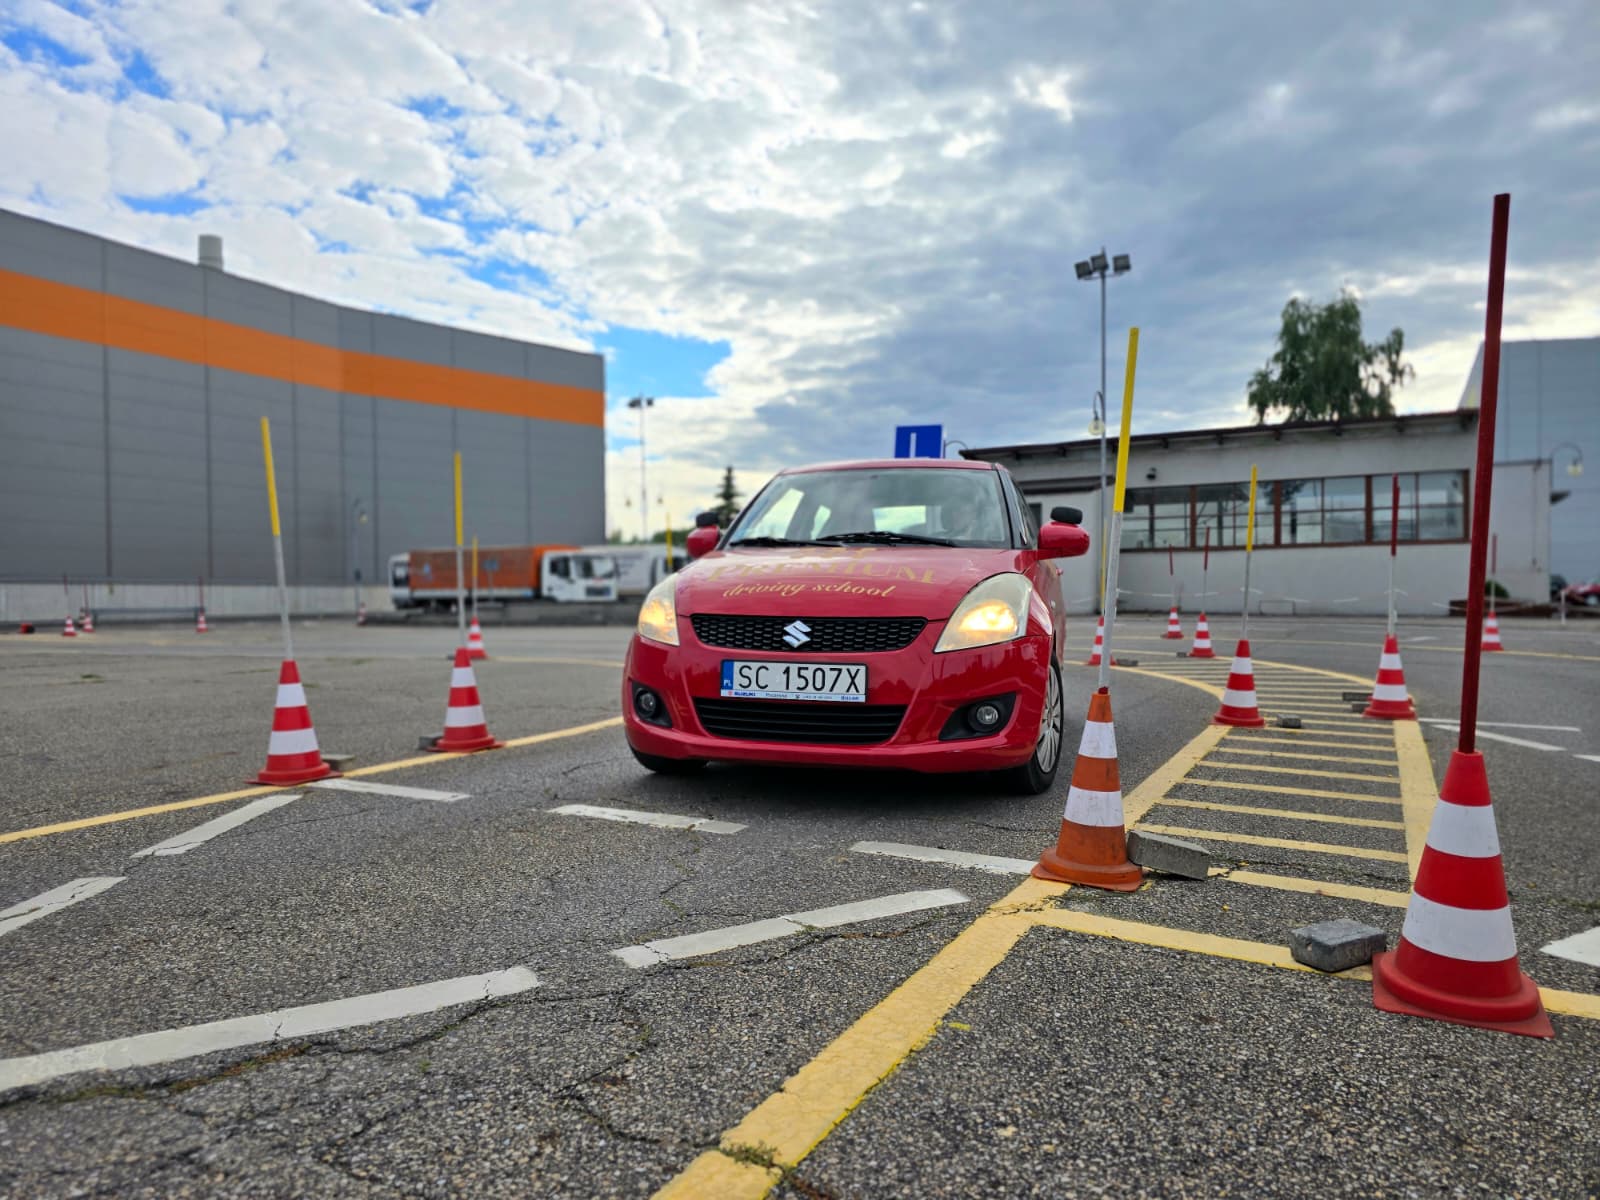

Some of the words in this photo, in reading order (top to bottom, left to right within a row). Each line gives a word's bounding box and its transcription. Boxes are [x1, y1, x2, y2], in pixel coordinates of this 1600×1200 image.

[708, 562, 936, 584] PREMIUM
[723, 582, 806, 597] driving
[813, 582, 896, 597] school
[723, 679, 732, 687] PL
[738, 665, 769, 689] SC
[783, 666, 860, 693] 1507X
